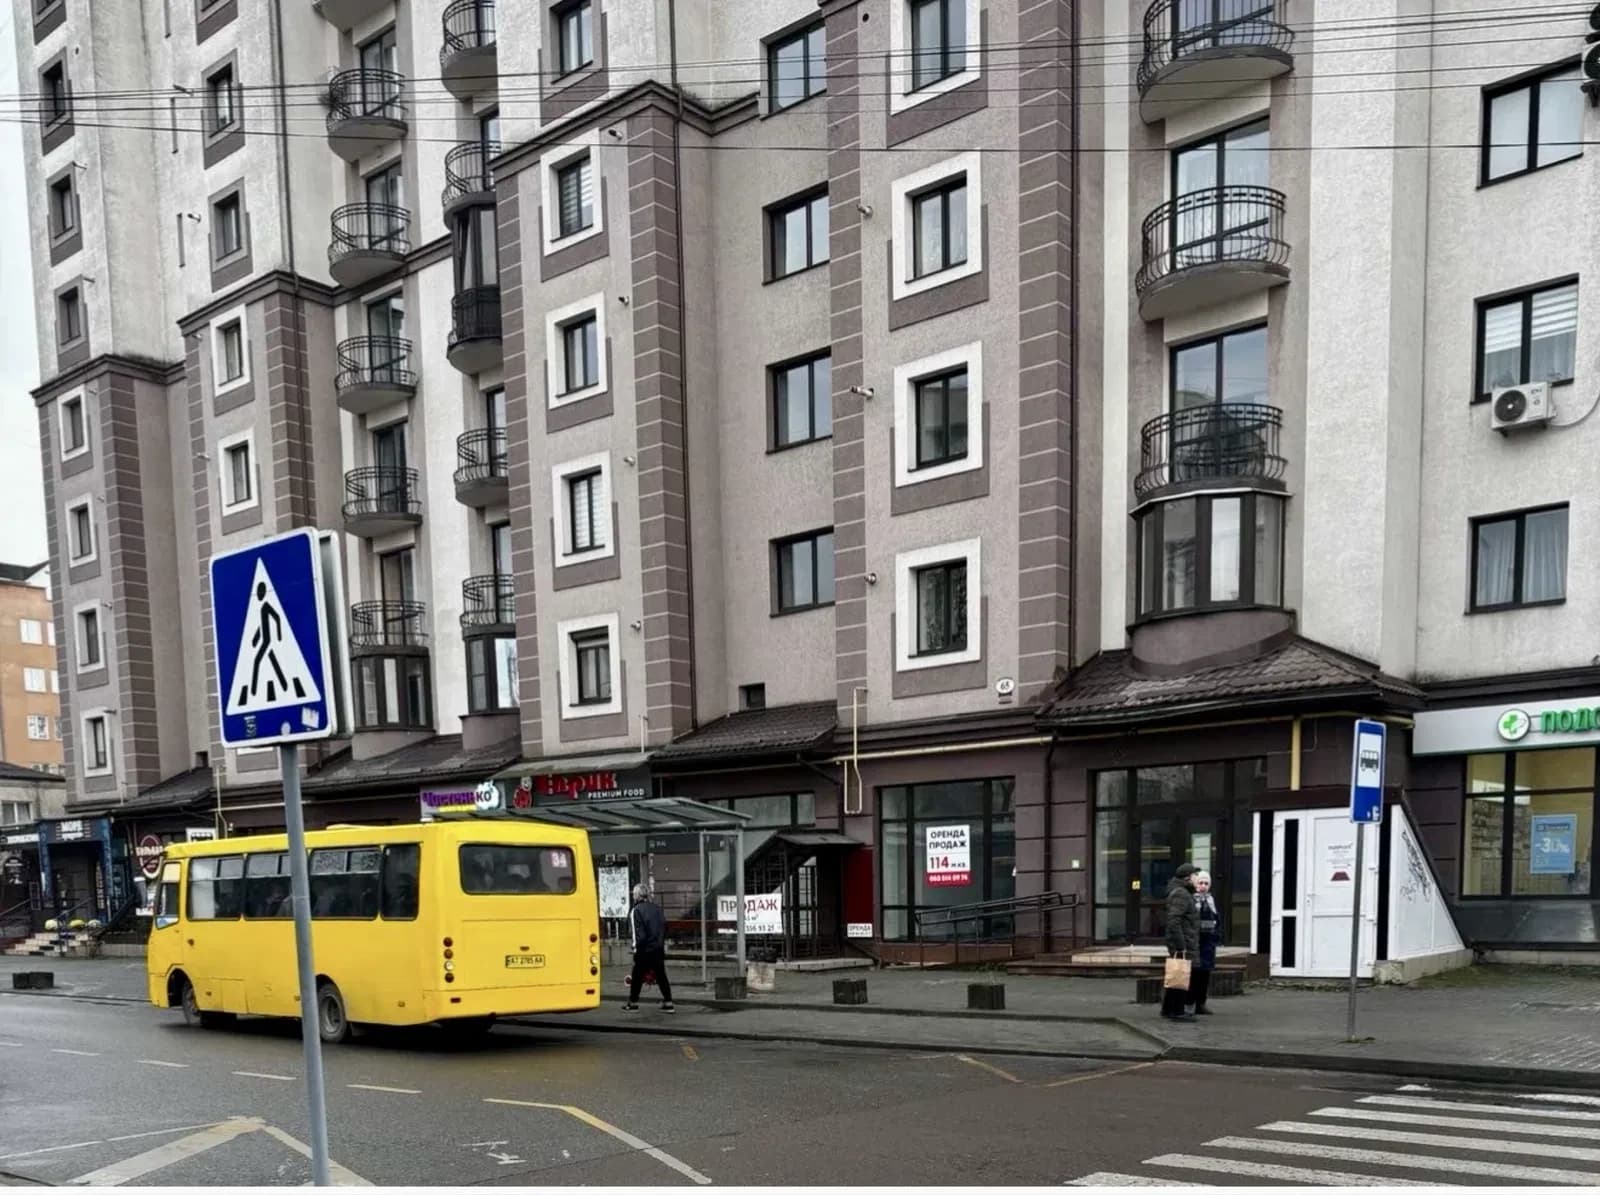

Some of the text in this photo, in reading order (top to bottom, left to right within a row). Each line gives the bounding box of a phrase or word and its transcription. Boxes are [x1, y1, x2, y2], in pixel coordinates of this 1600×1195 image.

[588, 788, 645, 799] PREMIUM FOOD
[930, 830, 965, 839] ОРЕНДА
[929, 840, 967, 850] ПРОДАЖ
[930, 856, 949, 869] 114
[721, 899, 778, 912] ПРДАЖ
